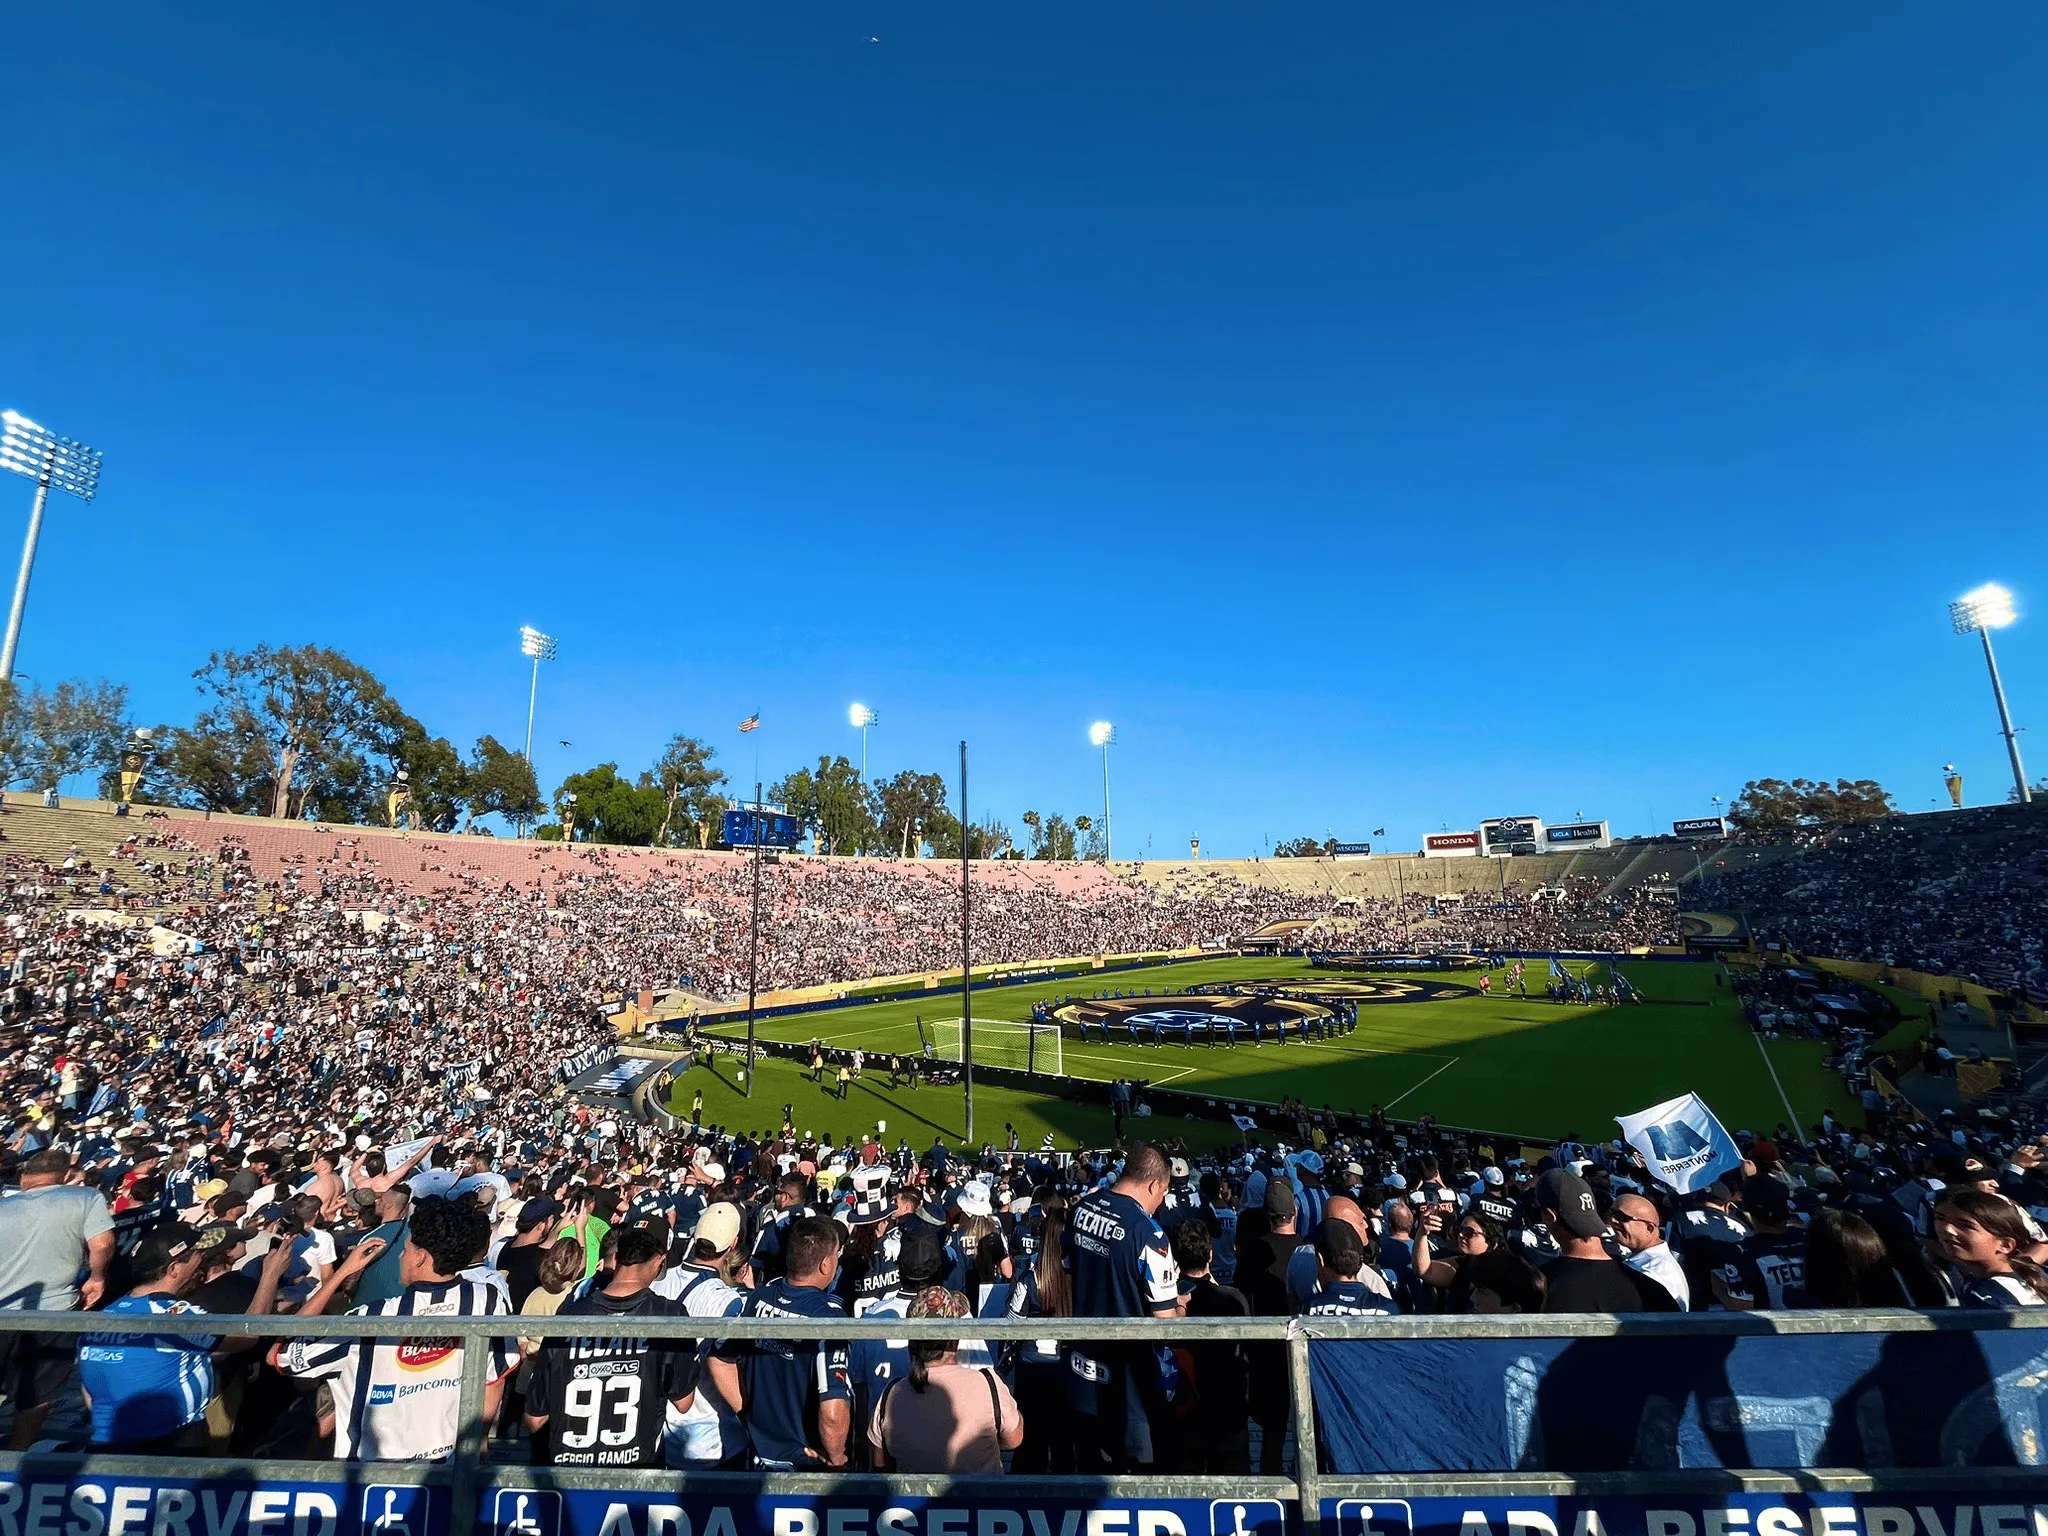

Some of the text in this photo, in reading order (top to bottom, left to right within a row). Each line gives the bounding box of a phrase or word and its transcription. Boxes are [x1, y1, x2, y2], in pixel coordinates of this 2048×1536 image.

[1573, 828, 1599, 837] Health
[1683, 821, 1719, 829] ACURA
[1433, 837, 1475, 845] HONDA
[1479, 1199, 1513, 1218] TECATE
[1073, 1206, 1118, 1240] TECATE
[854, 1269, 901, 1292] S.RAMOS
[1766, 1262, 1805, 1286] TEC
[418, 1302, 455, 1316] atletica
[564, 1337, 650, 1360] TECATE
[371, 1377, 463, 1400] BBVA Bancome
[562, 1375, 642, 1449] 93
[554, 1446, 640, 1465] SERGIO RAMOS
[0, 1482, 338, 1536] RESERVED
[1646, 1505, 2048, 1536] RESERVE
